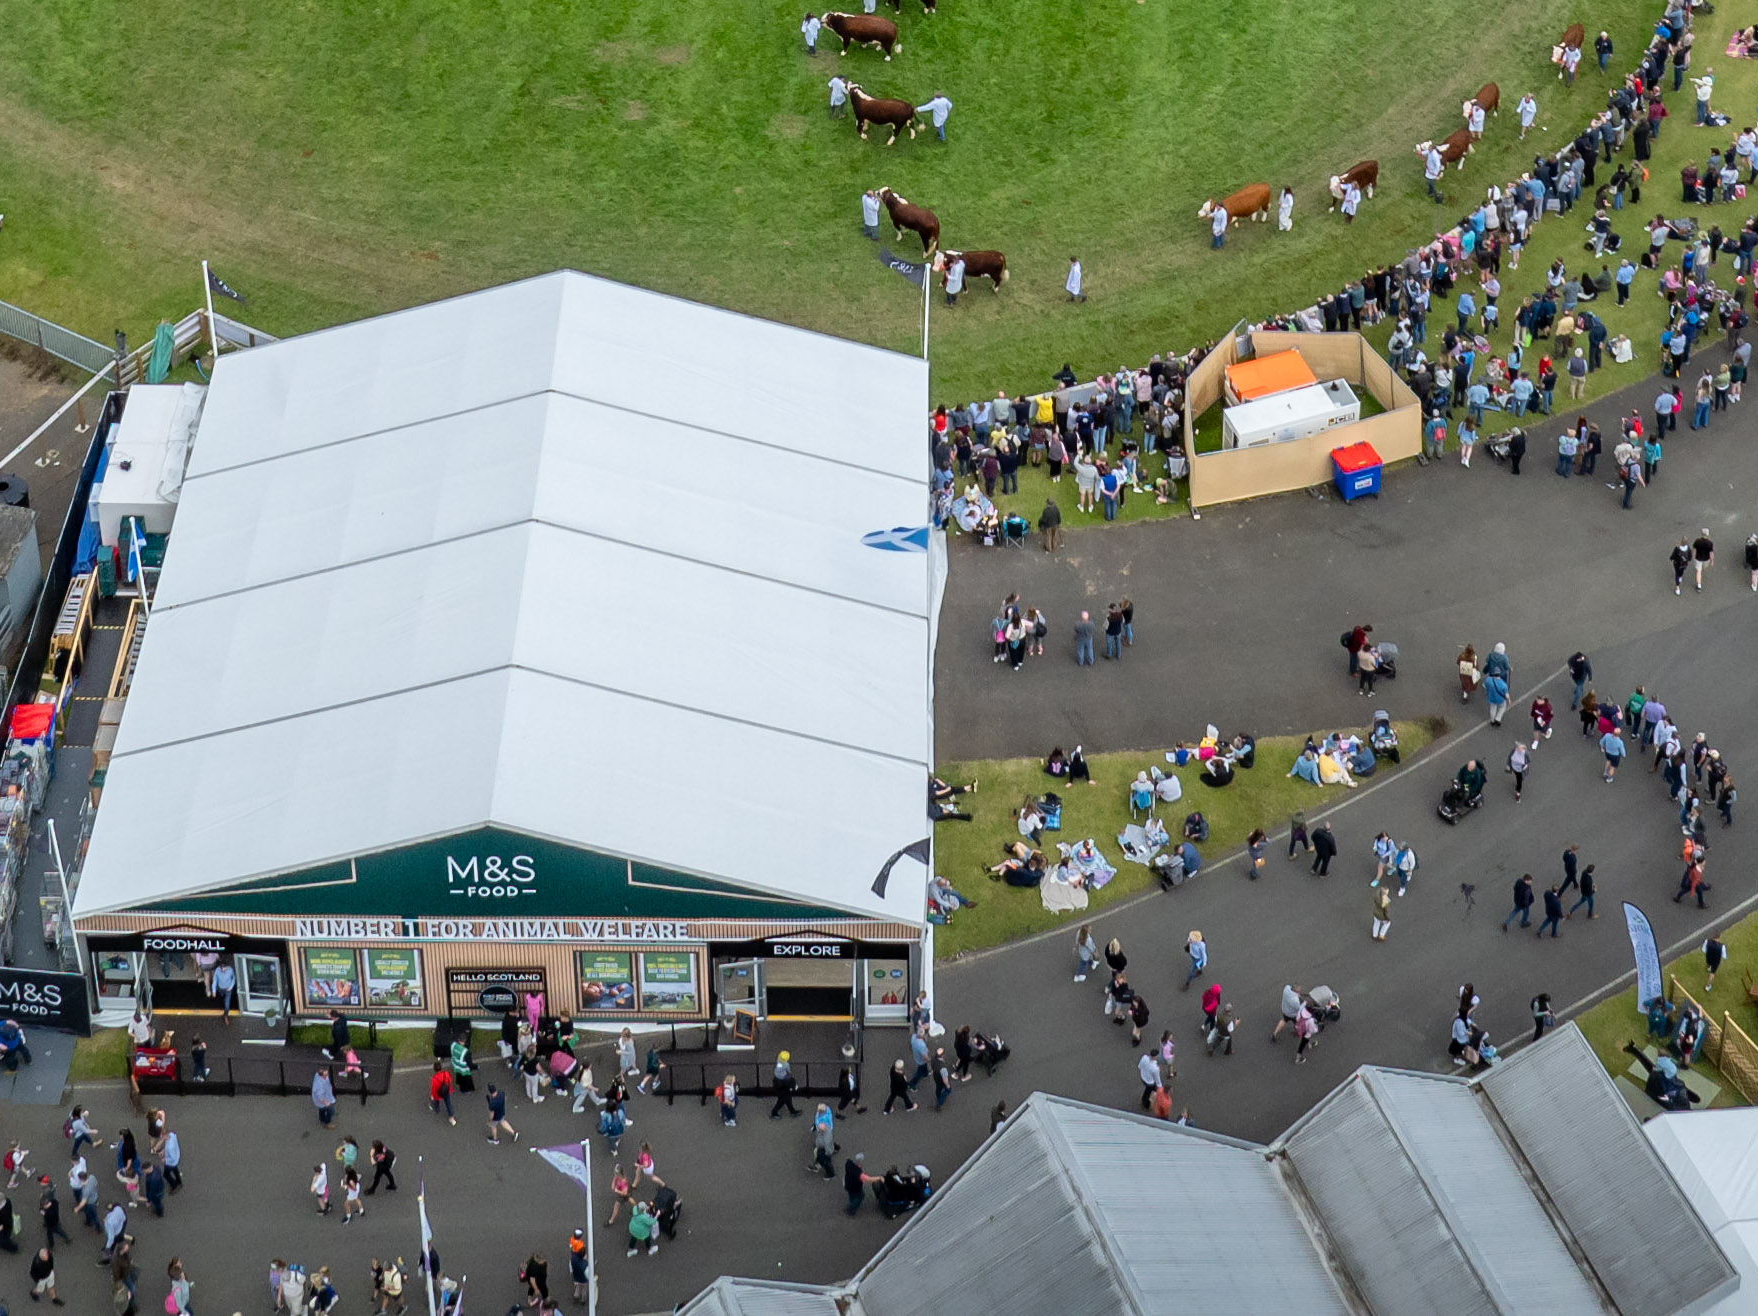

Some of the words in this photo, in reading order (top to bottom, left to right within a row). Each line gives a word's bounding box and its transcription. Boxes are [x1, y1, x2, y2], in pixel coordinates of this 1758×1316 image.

[446, 855, 536, 883] M&S
[467, 885, 517, 896] FOOD
[295, 919, 395, 941] NUMBER
[401, 918, 417, 942] 1
[427, 920, 475, 941] FOR
[483, 920, 578, 941] ANIMAL
[583, 920, 690, 941] WELFARE
[143, 938, 226, 951] FOODHALL
[773, 944, 841, 956] EXPLORE
[453, 973, 486, 982] HELLO
[487, 973, 540, 982] SCOTLAND
[12, 1002, 48, 1015] FOOD
